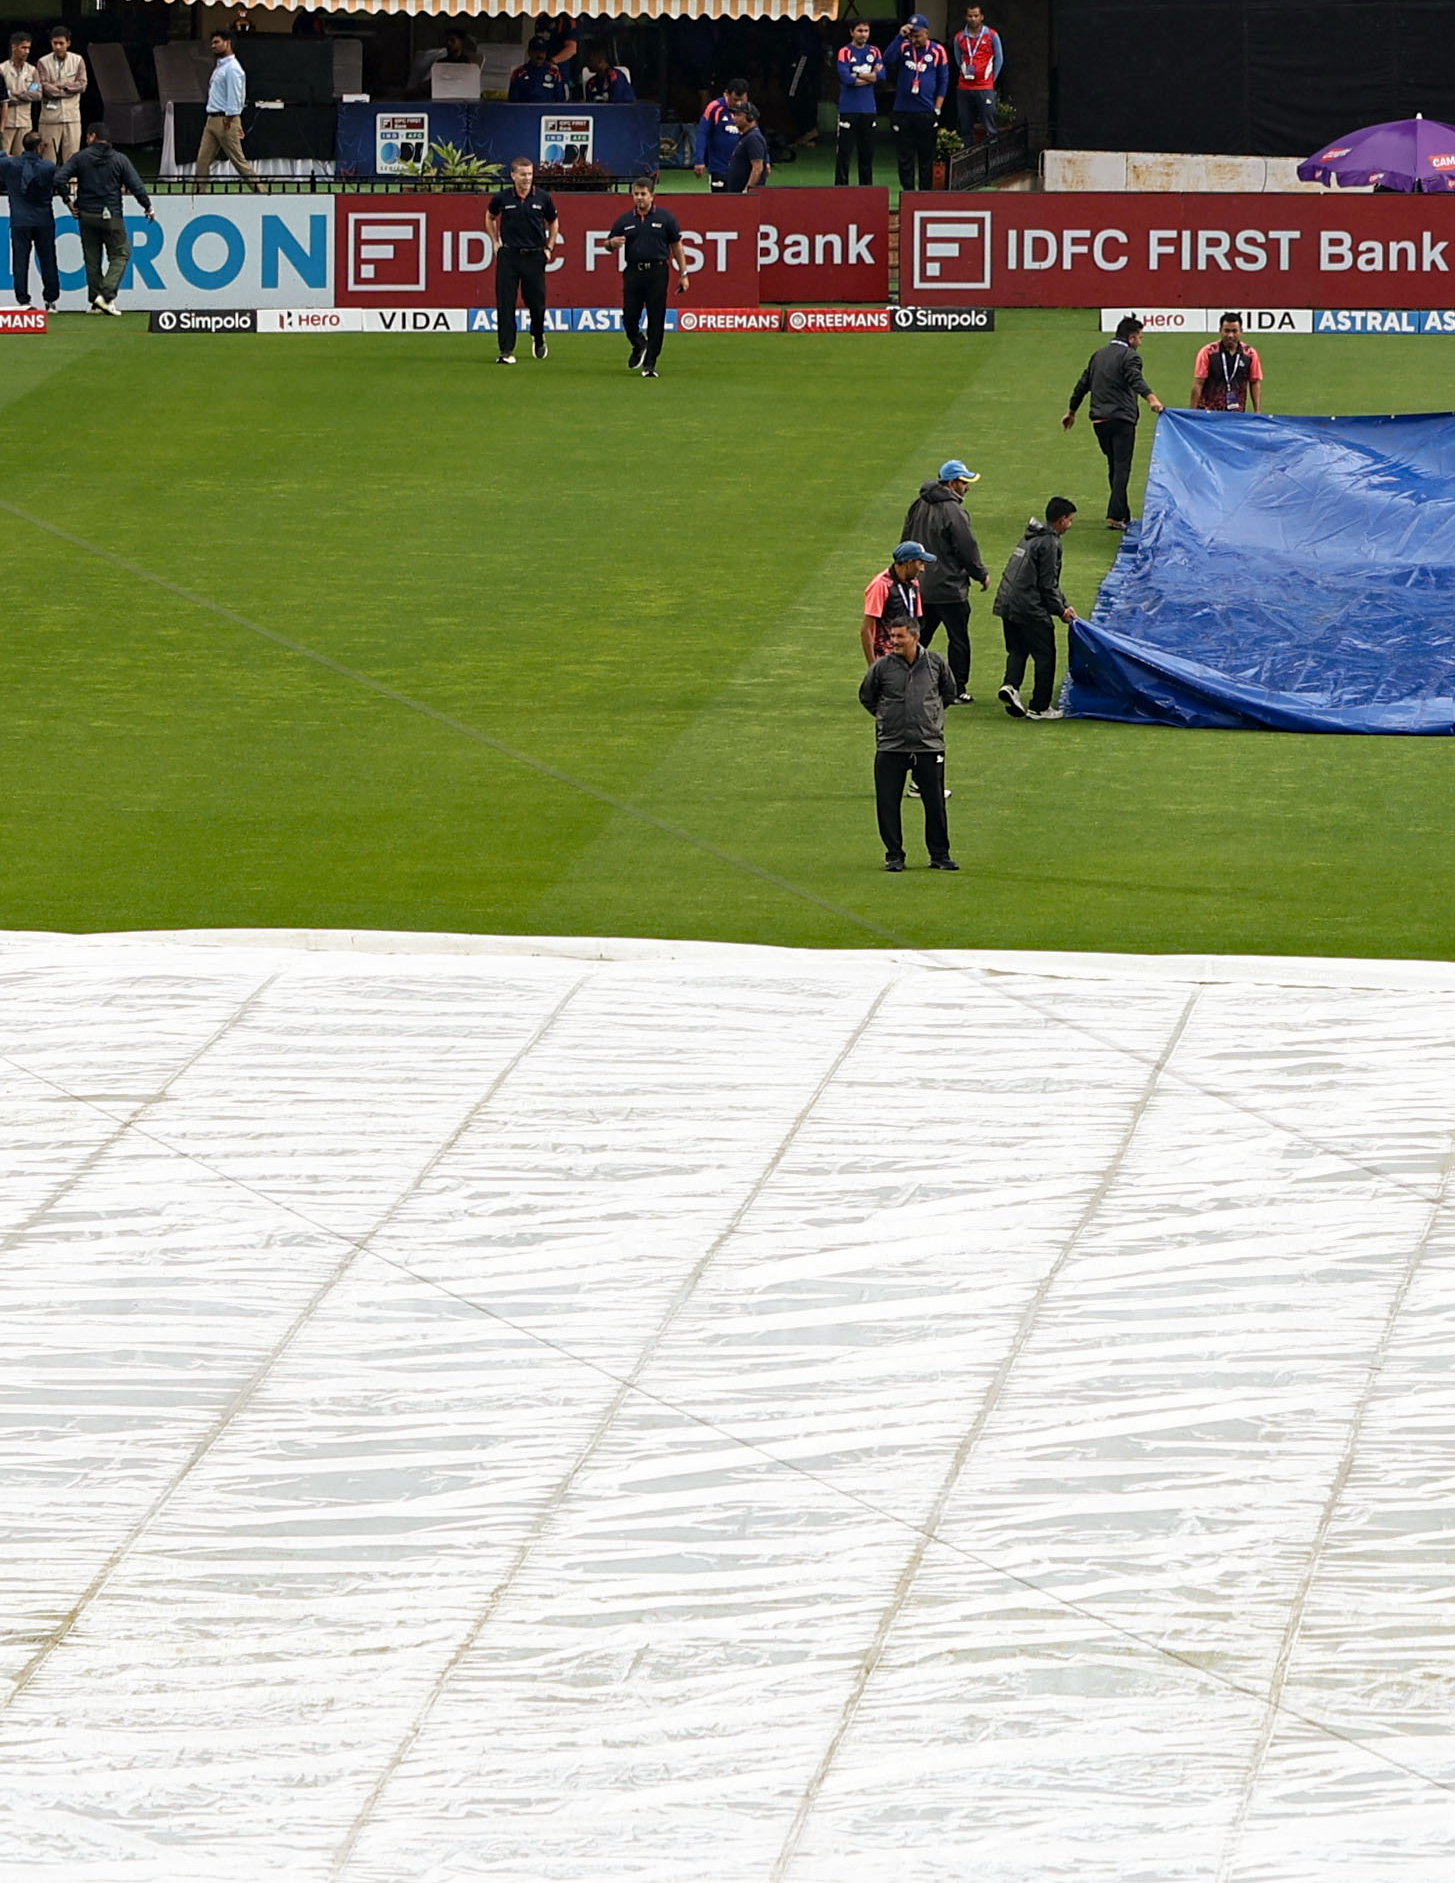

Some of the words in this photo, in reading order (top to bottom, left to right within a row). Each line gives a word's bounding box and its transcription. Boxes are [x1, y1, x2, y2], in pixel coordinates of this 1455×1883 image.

[442, 230, 565, 273] IDC
[759, 224, 876, 265] Bank
[1008, 229, 1128, 271] IDFC
[1149, 229, 1301, 271] FIRST
[1319, 231, 1449, 272] Bank
[179, 313, 251, 333] Simpolo
[379, 311, 451, 330] VIDA
[698, 314, 779, 330] FREEMANS
[808, 313, 889, 328] FREEMANS
[916, 310, 988, 330] Simpolo
[1224, 311, 1295, 330] IDA
[1318, 311, 1415, 332] ASTRAL
